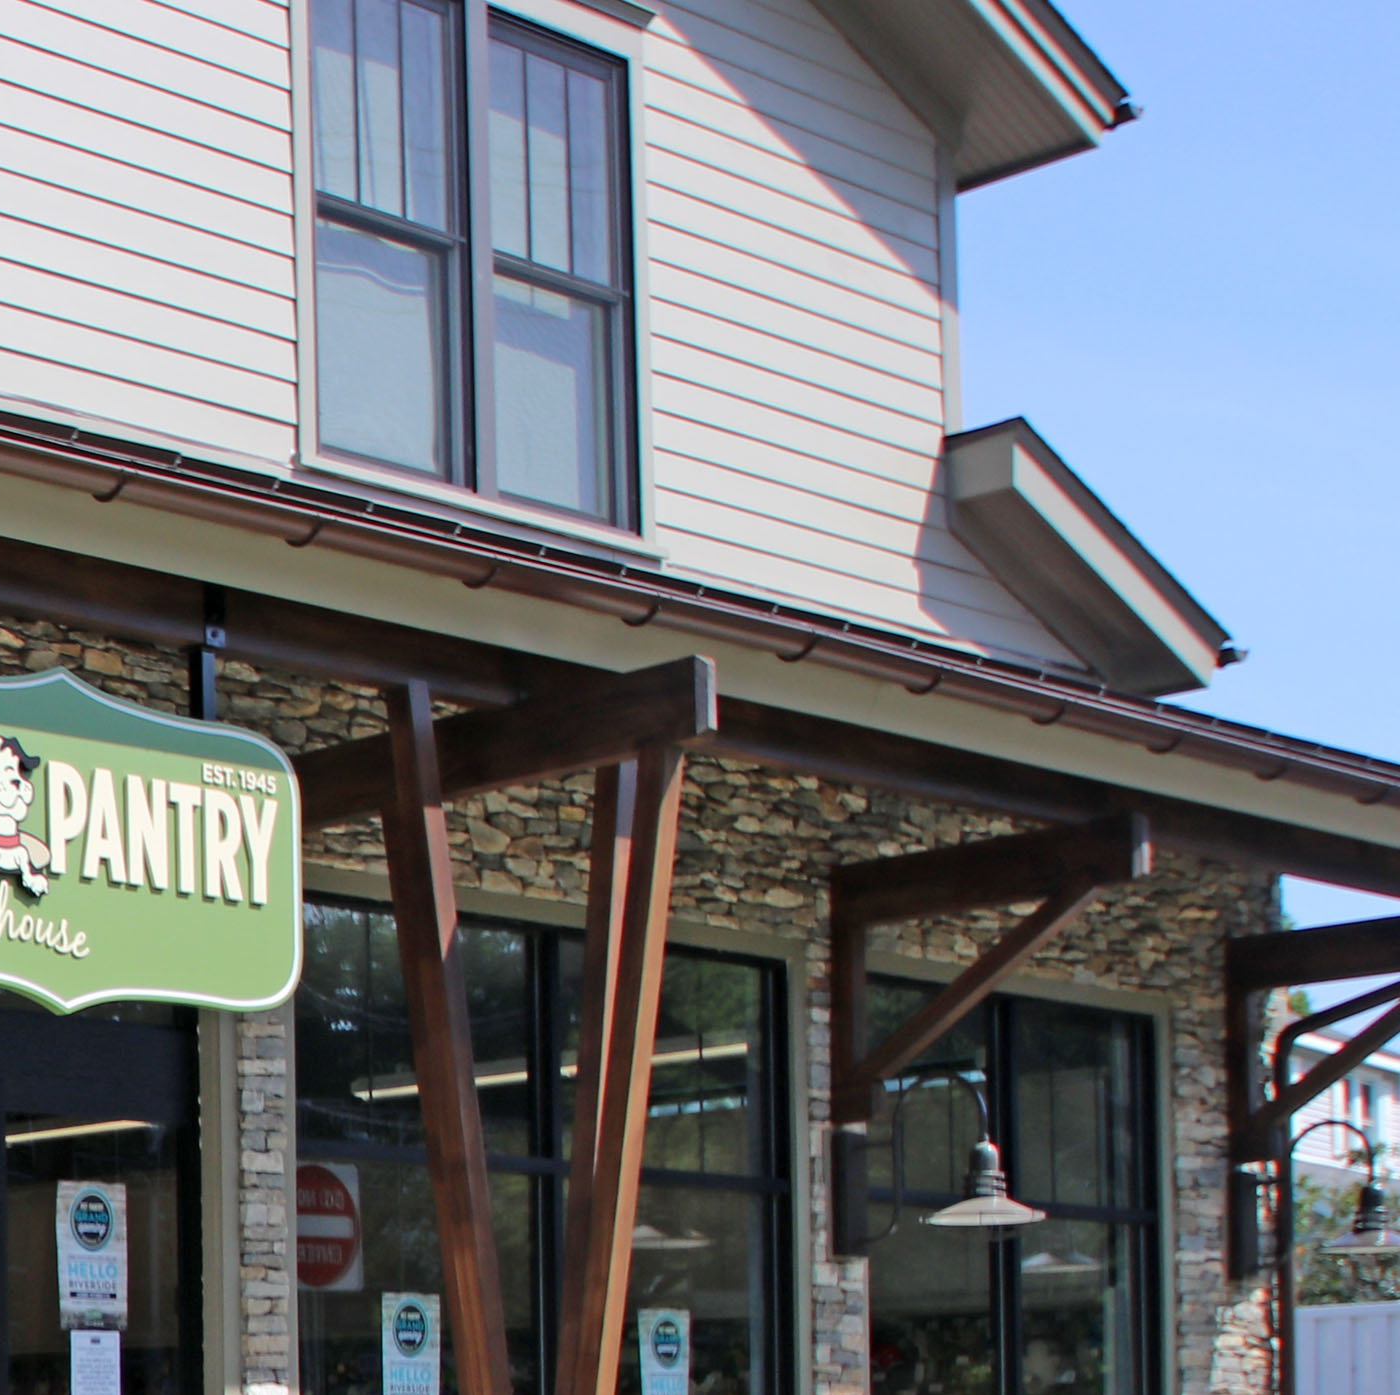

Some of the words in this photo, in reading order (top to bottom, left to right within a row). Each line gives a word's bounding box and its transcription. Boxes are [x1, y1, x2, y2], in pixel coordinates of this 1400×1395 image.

[203, 763, 238, 788] EST.
[239, 770, 277, 794] 1945
[48, 760, 278, 905] PANTRY
[68, 1262, 119, 1279] HELLO
[390, 1367, 432, 1382] HELLO
